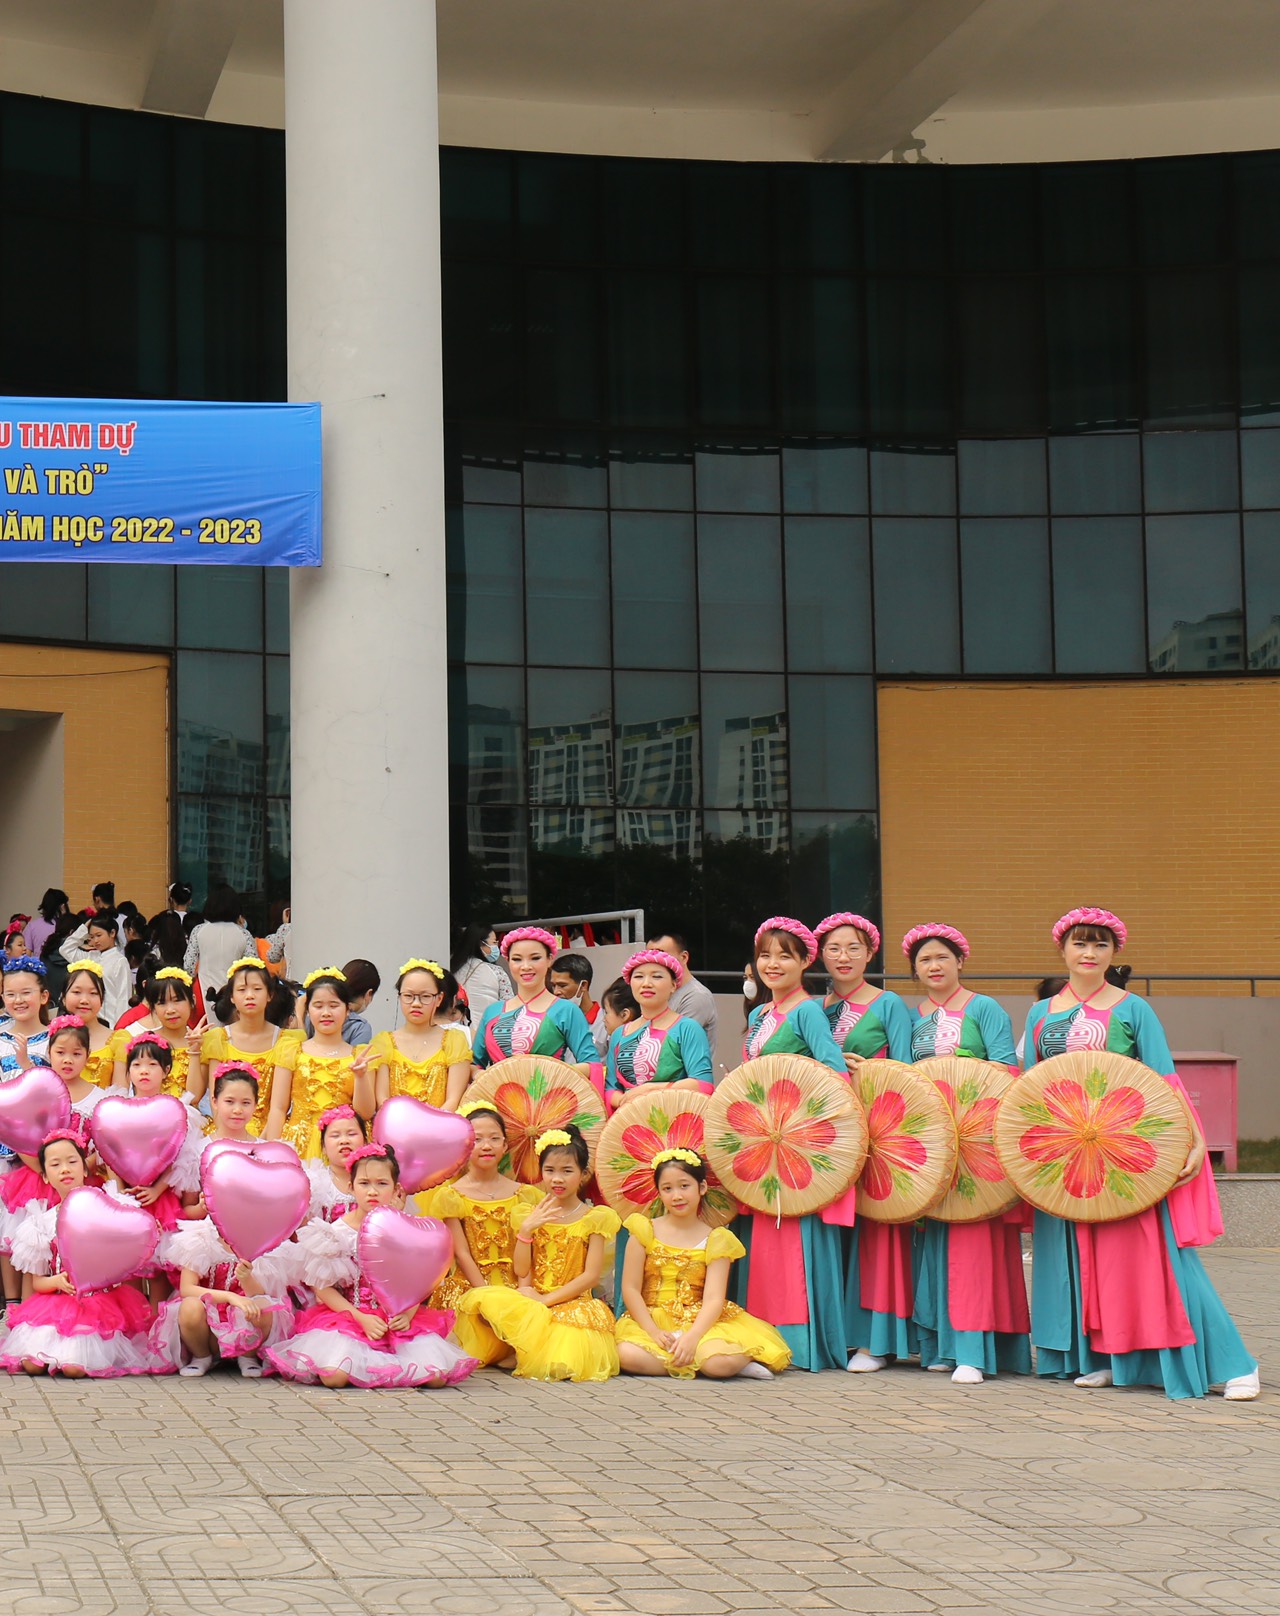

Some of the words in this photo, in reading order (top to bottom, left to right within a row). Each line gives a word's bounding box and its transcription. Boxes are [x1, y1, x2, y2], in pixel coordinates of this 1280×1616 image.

[18, 420, 91, 449] THAM
[98, 420, 137, 455] DỰ
[4, 463, 39, 494] VÀ
[52, 515, 104, 547] HỌC
[111, 517, 175, 543] 2022
[198, 517, 262, 544] 2023
